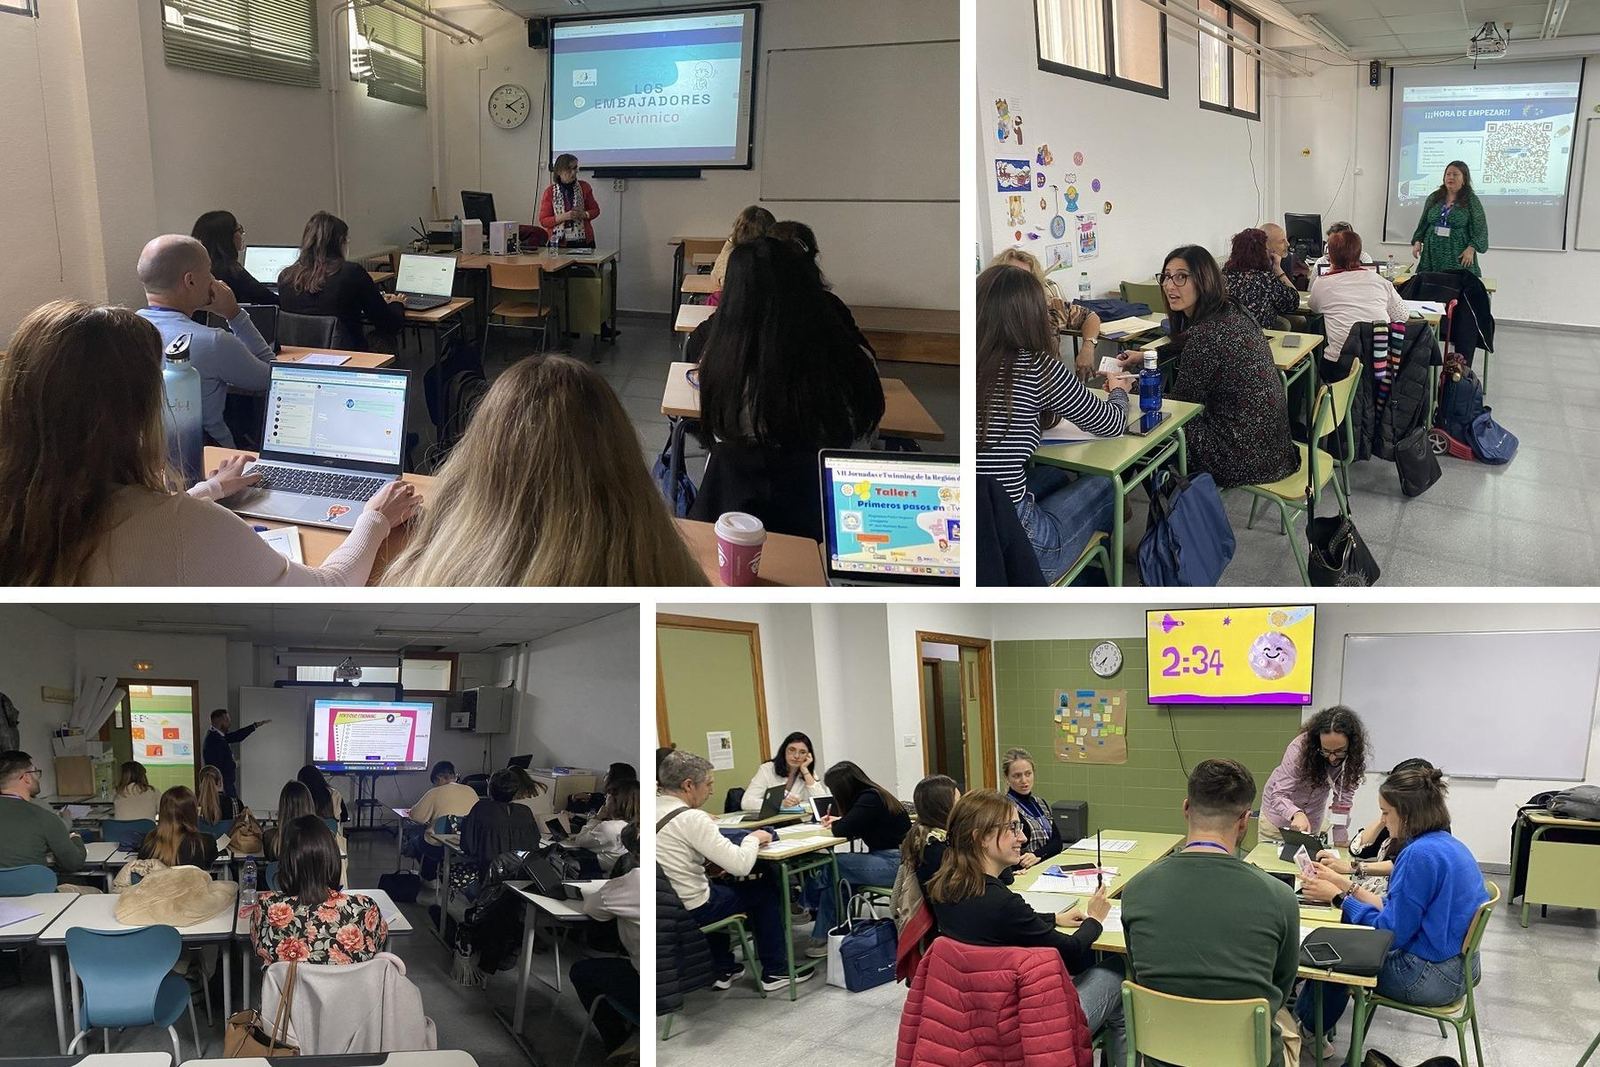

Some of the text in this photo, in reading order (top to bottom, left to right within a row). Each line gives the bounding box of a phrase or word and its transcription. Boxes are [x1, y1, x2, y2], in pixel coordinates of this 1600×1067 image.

[634, 83, 663, 94] LOS
[594, 94, 711, 109] EMBAJADORES
[1468, 109, 1511, 117] EMPEZAR!!
[608, 112, 680, 125] eTwinnico
[879, 472, 915, 481] eTwinning
[932, 474, 957, 482] Región
[875, 488, 909, 497] Taller
[858, 501, 901, 510] Primeros
[903, 503, 931, 511] pasos
[1162, 645, 1224, 677] 2:34
